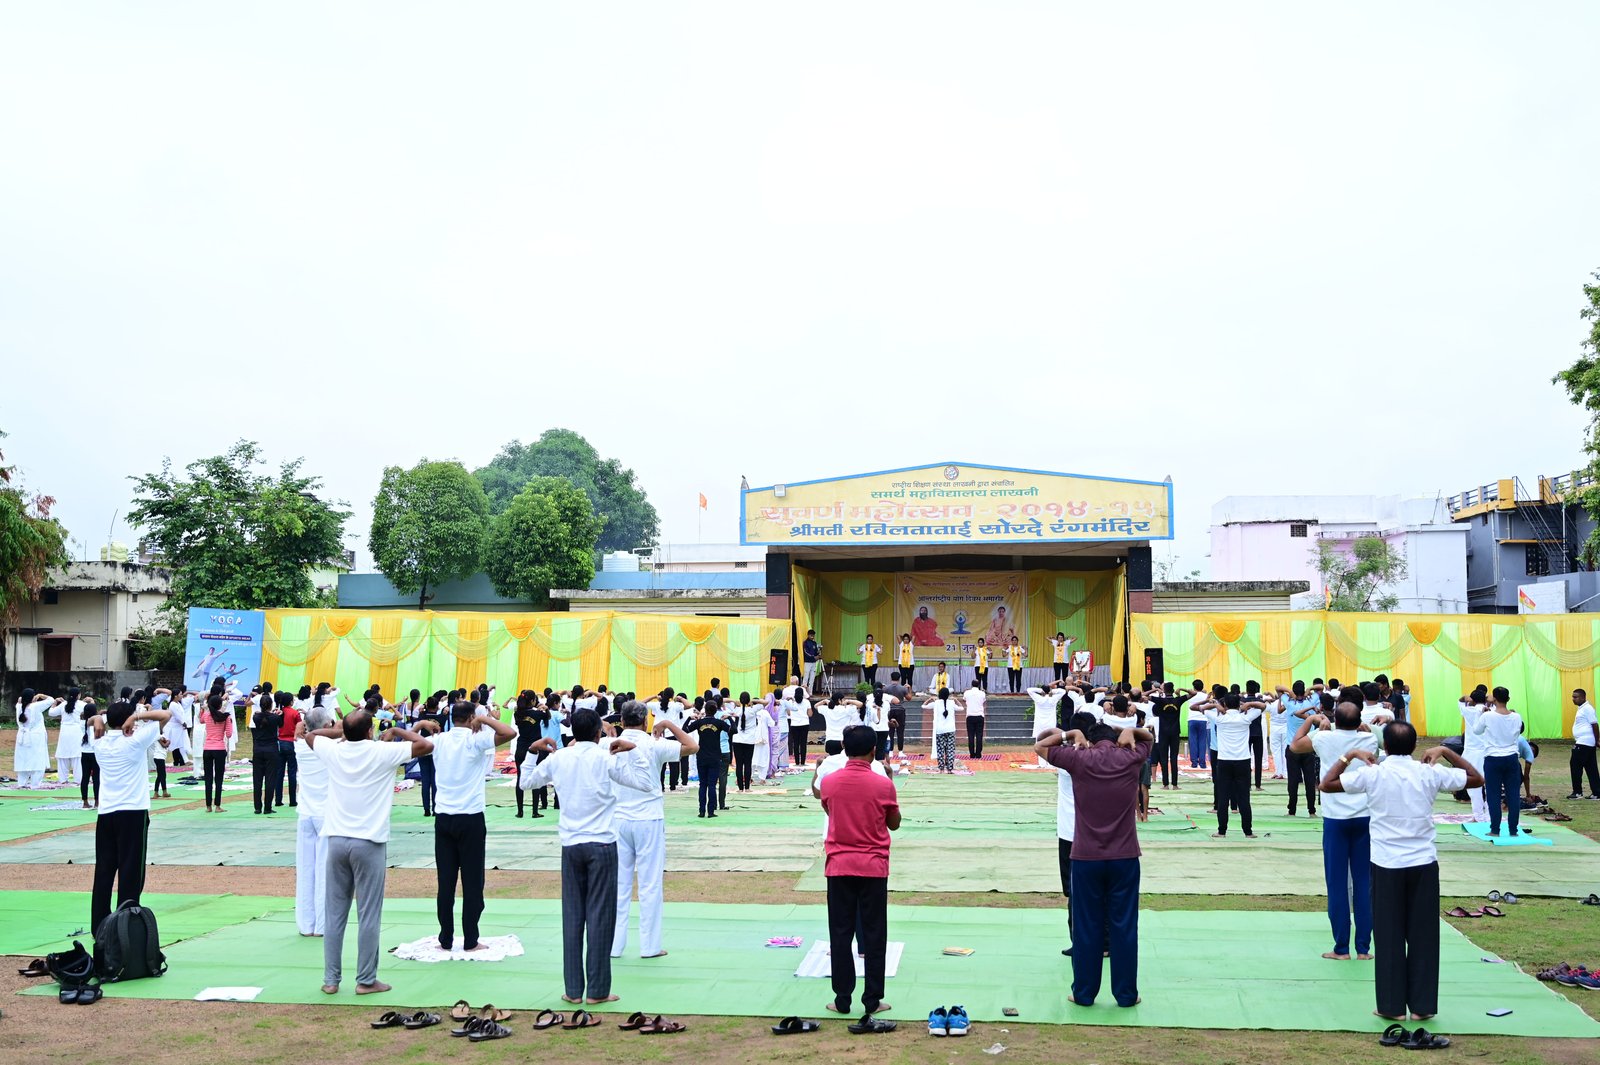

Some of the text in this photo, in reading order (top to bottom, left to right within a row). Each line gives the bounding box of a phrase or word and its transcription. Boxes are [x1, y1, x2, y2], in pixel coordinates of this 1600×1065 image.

[871, 486, 1039, 500] समर्थ महाविद्यालय लाखनी
[849, 500, 973, 523] महोत्सव
[996, 500, 1088, 519] २०१४
[789, 517, 1151, 538] श्रीमती रविलताताई सोरदे रंगमंदिर
[210, 616, 242, 624] YOGA
[946, 644, 956, 652] 21
